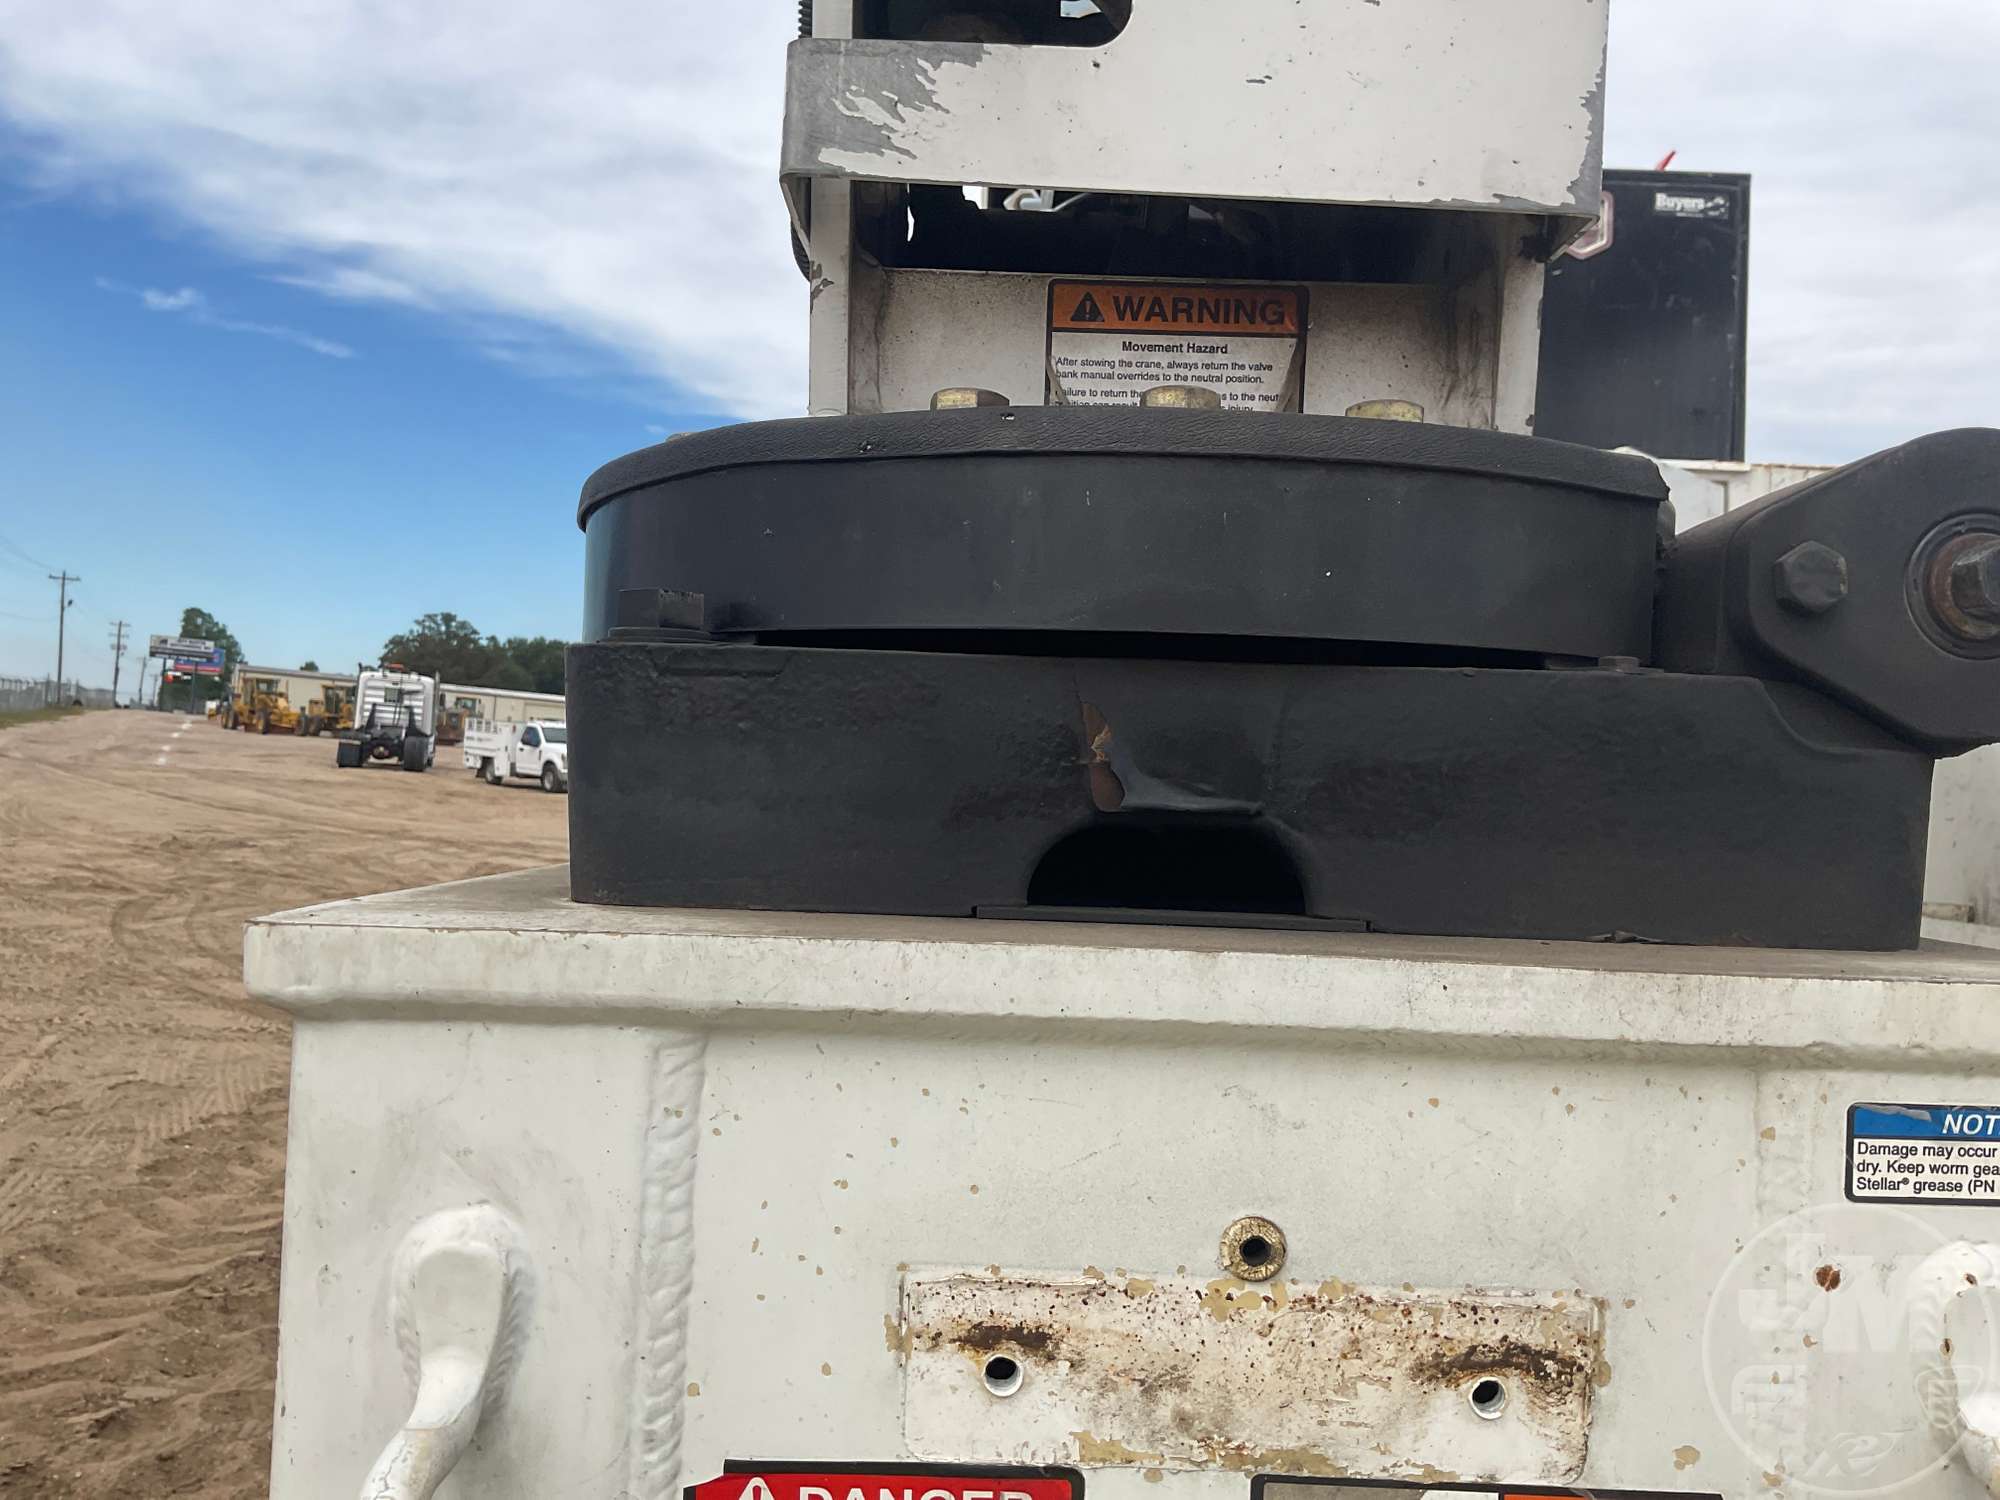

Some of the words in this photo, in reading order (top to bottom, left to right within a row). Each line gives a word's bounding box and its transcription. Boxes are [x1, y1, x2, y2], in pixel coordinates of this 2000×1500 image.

[1113, 295, 1285, 325] WARNING
[1121, 341, 1183, 353] Movement
[1186, 342, 1228, 354] Hazard
[1055, 357, 1077, 366] After
[1080, 358, 1115, 369] stowing
[1118, 359, 1133, 367] the
[1135, 361, 1164, 370] crane,
[1166, 360, 1199, 371] always
[1201, 362, 1228, 370] return
[1231, 362, 1245, 371] the
[1248, 362, 1273, 371] valve
[1056, 369, 1078, 378] bank
[1080, 370, 1114, 380] manual
[1116, 371, 1160, 381] overrides
[1162, 373, 1172, 381] to
[1174, 373, 1188, 382] the
[1191, 373, 1223, 382] neutral
[1225, 374, 1264, 384] position.
[1089, 389, 1098, 397] to
[1100, 389, 1127, 397] return
[1229, 392, 1238, 401] to
[1241, 393, 1255, 401] the
[1258, 394, 1279, 402] neut
[1942, 1113, 2000, 1135] NOT
[1857, 1141, 1918, 1159] Damage
[1922, 1146, 1953, 1160] may
[1957, 1147, 1998, 1158] occur
[1857, 1159, 1882, 1176] dry.
[1887, 1160, 1925, 1176] Keep
[1929, 1164, 1968, 1175] worm
[1913, 1180, 1963, 1194] grease
[1968, 1179, 1995, 1195] (PN
